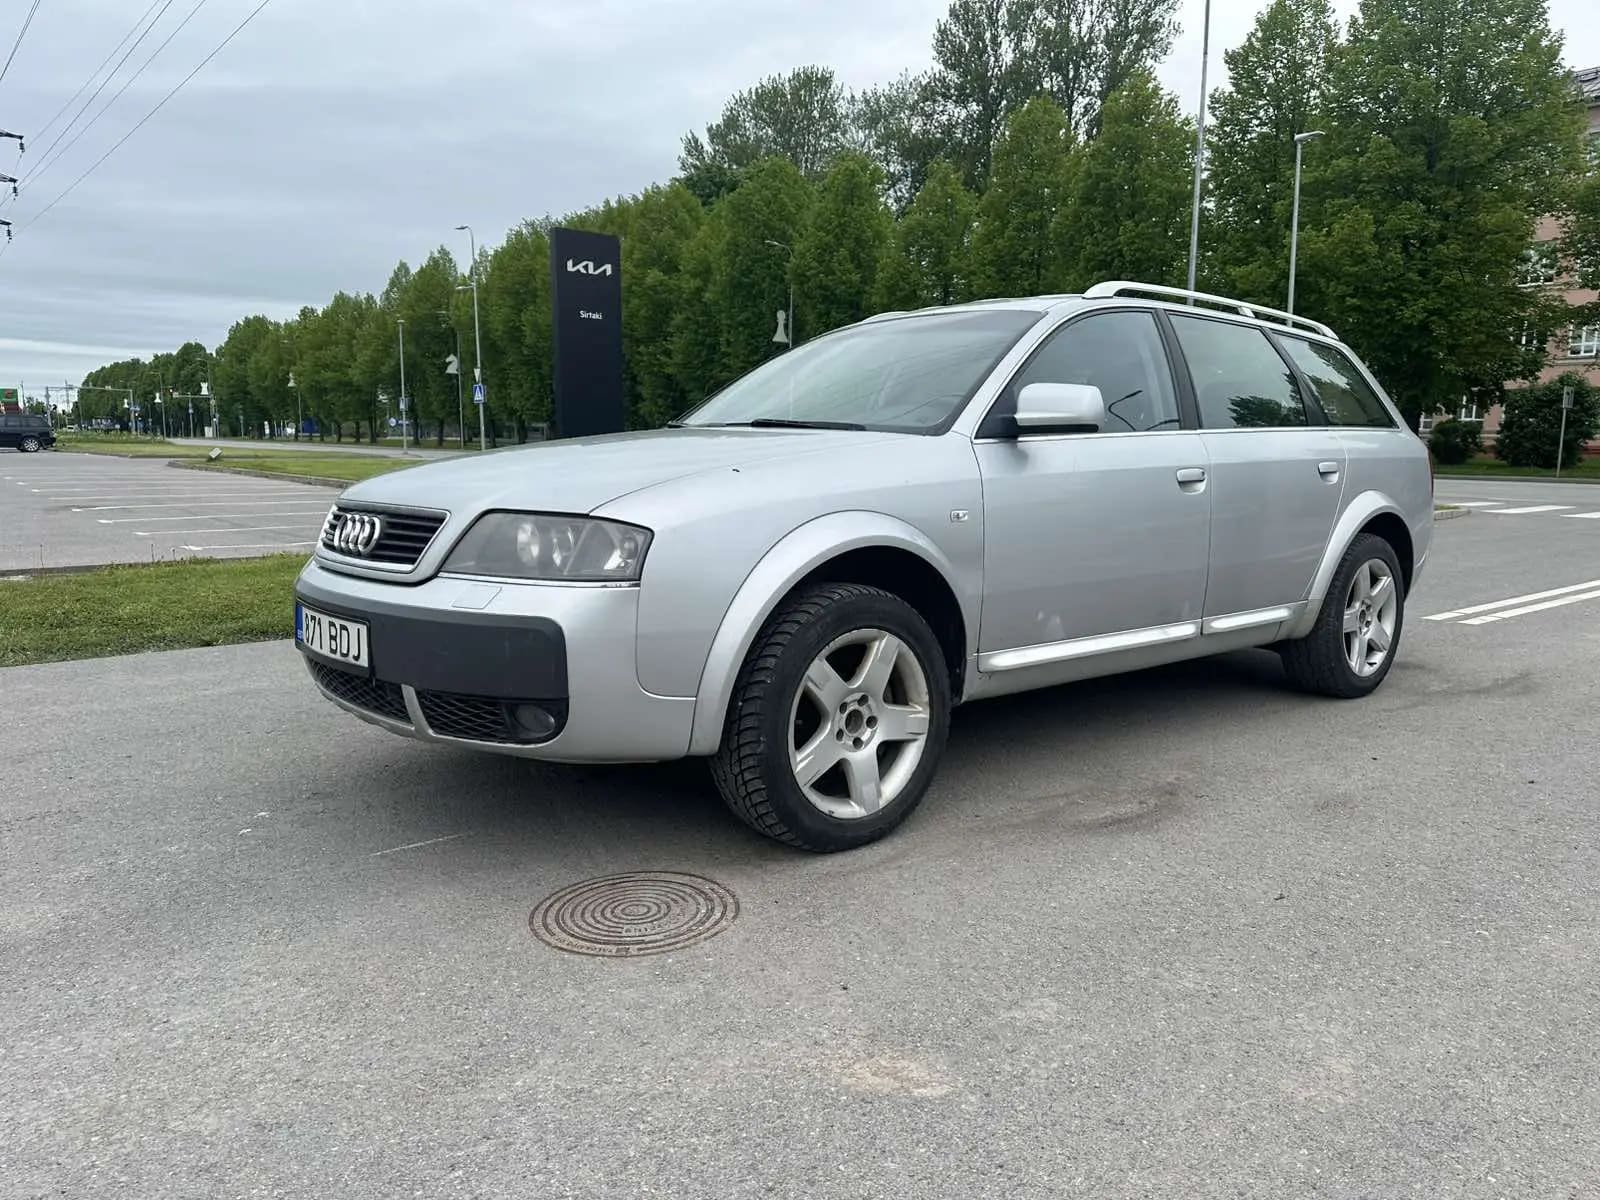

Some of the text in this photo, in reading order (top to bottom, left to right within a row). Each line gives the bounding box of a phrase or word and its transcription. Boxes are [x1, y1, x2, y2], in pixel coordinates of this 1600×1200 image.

[579, 310, 603, 320] Sirtaki
[305, 612, 361, 662] 871 BDJ
